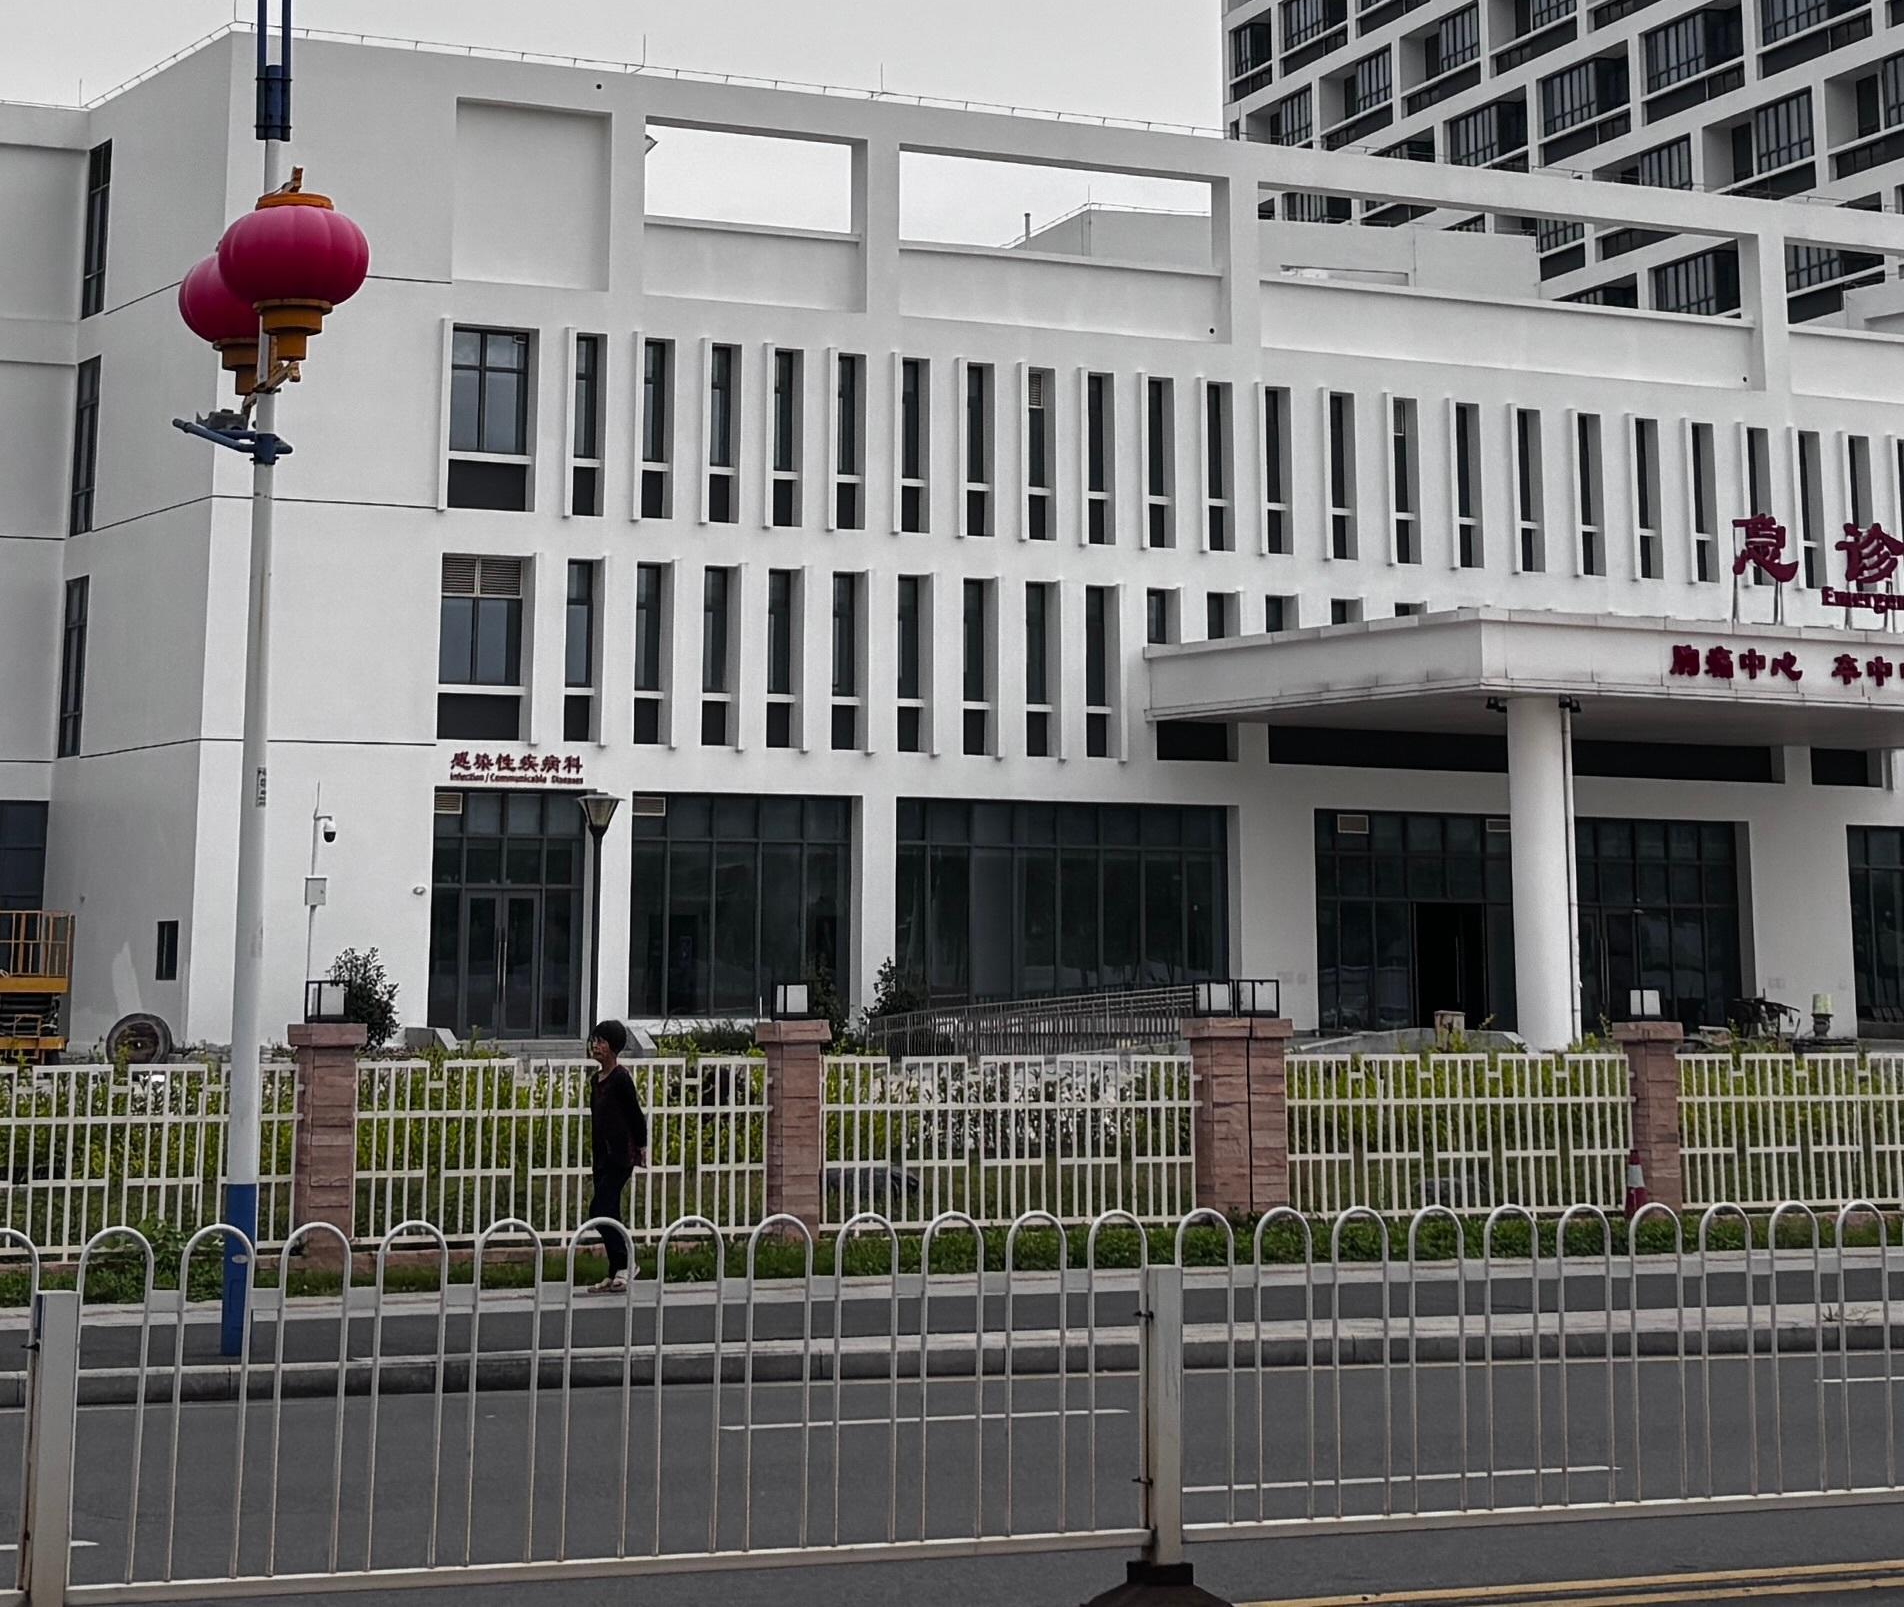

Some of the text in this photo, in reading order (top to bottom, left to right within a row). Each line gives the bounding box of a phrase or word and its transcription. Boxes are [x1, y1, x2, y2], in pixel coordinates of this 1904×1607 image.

[450, 751, 584, 774] 感染性疾病科
